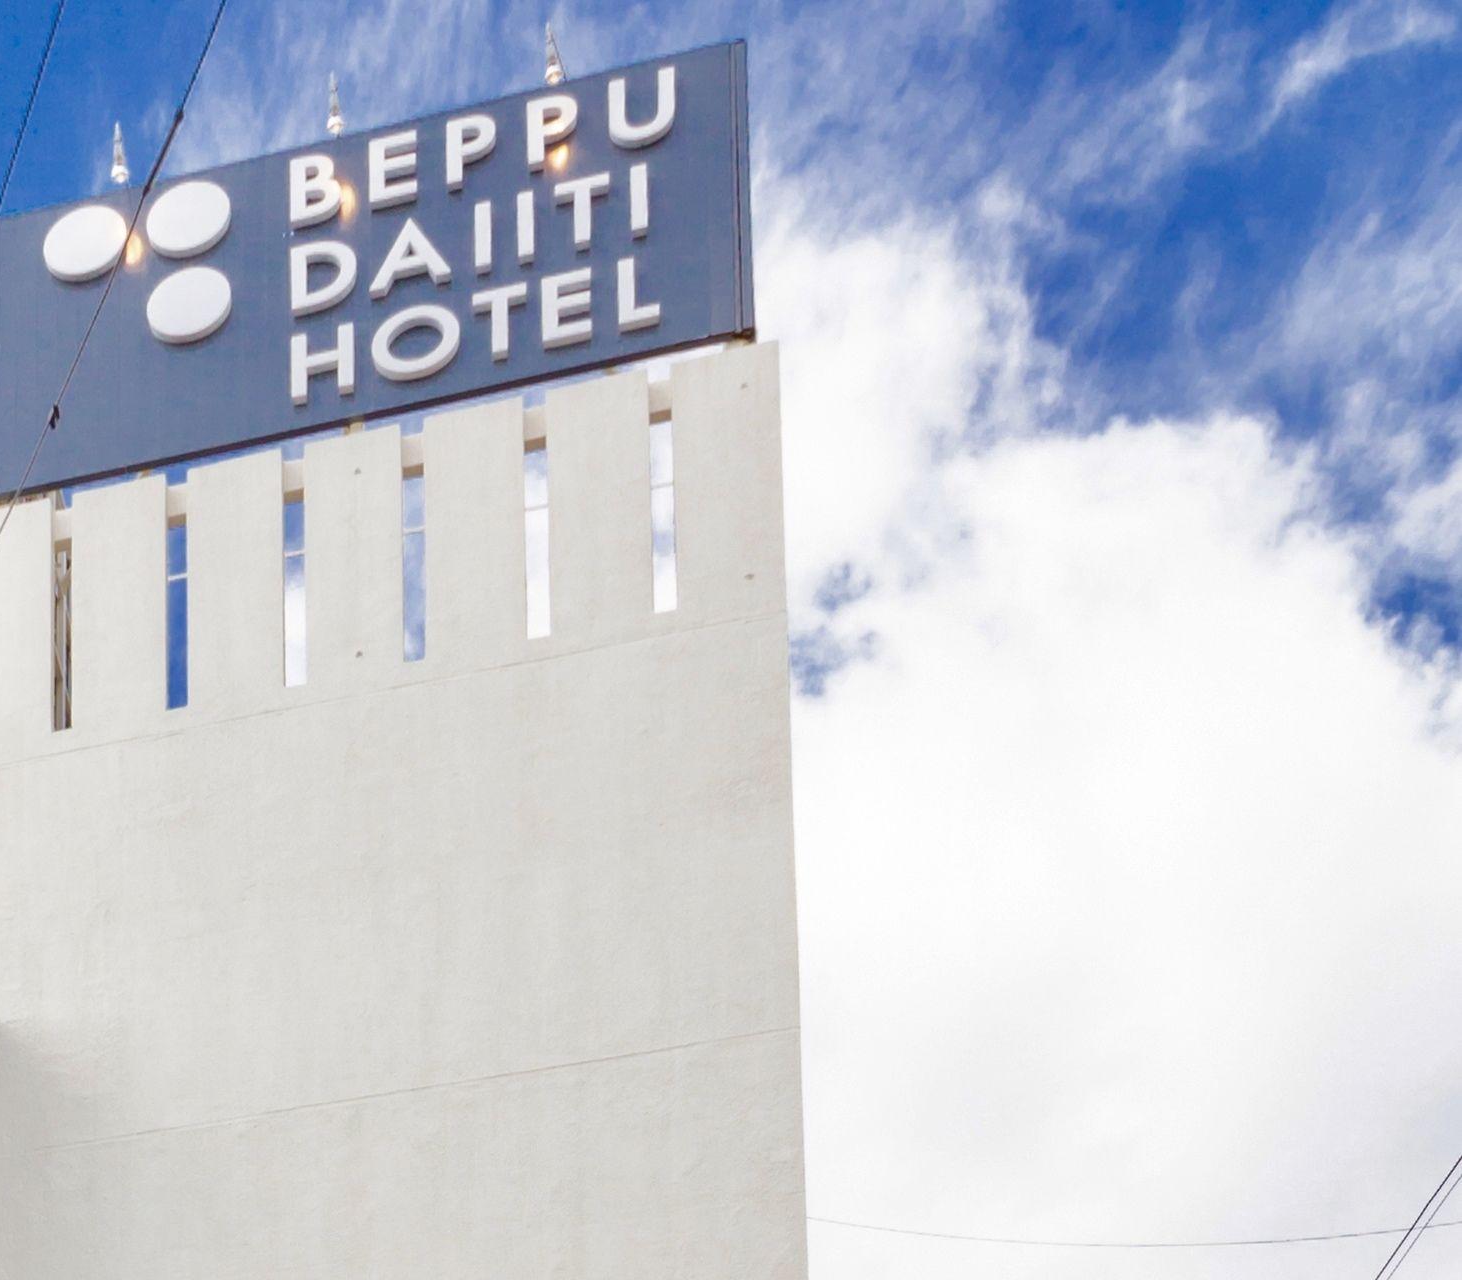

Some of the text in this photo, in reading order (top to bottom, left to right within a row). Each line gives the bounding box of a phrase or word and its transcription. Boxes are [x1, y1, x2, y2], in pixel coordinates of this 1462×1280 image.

[289, 66, 676, 230] BEPPU
[289, 163, 650, 318] DAIITI
[290, 257, 662, 406] HOTEL
